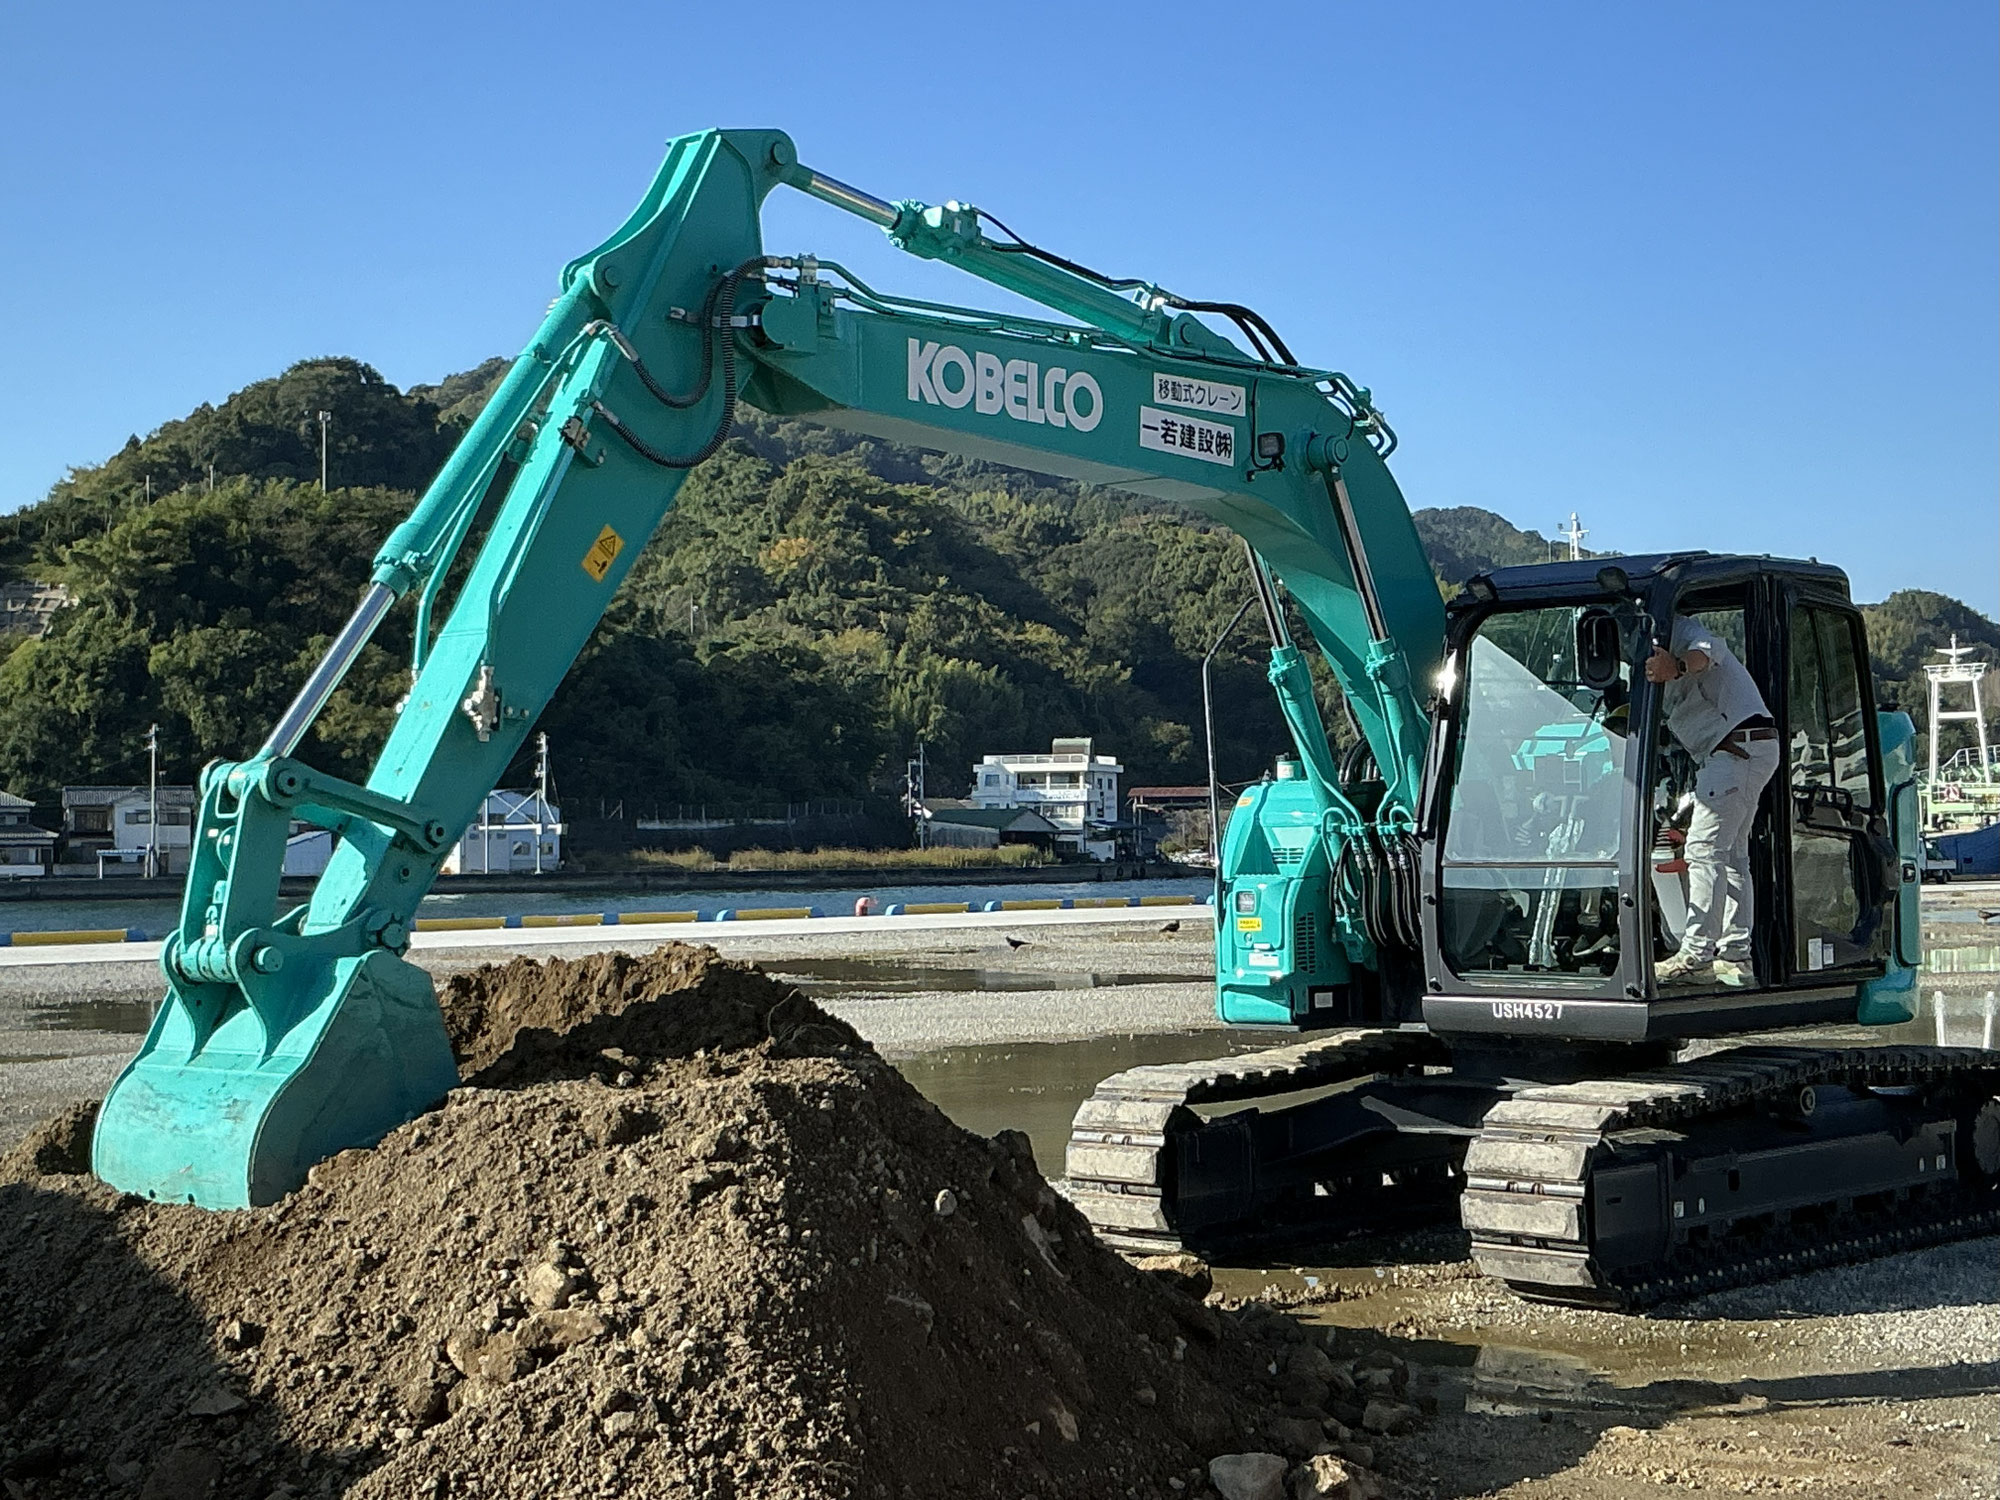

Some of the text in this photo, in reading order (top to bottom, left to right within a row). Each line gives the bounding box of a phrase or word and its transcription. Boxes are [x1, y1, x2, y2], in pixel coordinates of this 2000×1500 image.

[908, 337, 1103, 432] KOBELCO
[1158, 379, 1242, 410] 移動式クレーン
[1492, 1002, 1563, 1020] USH4527
